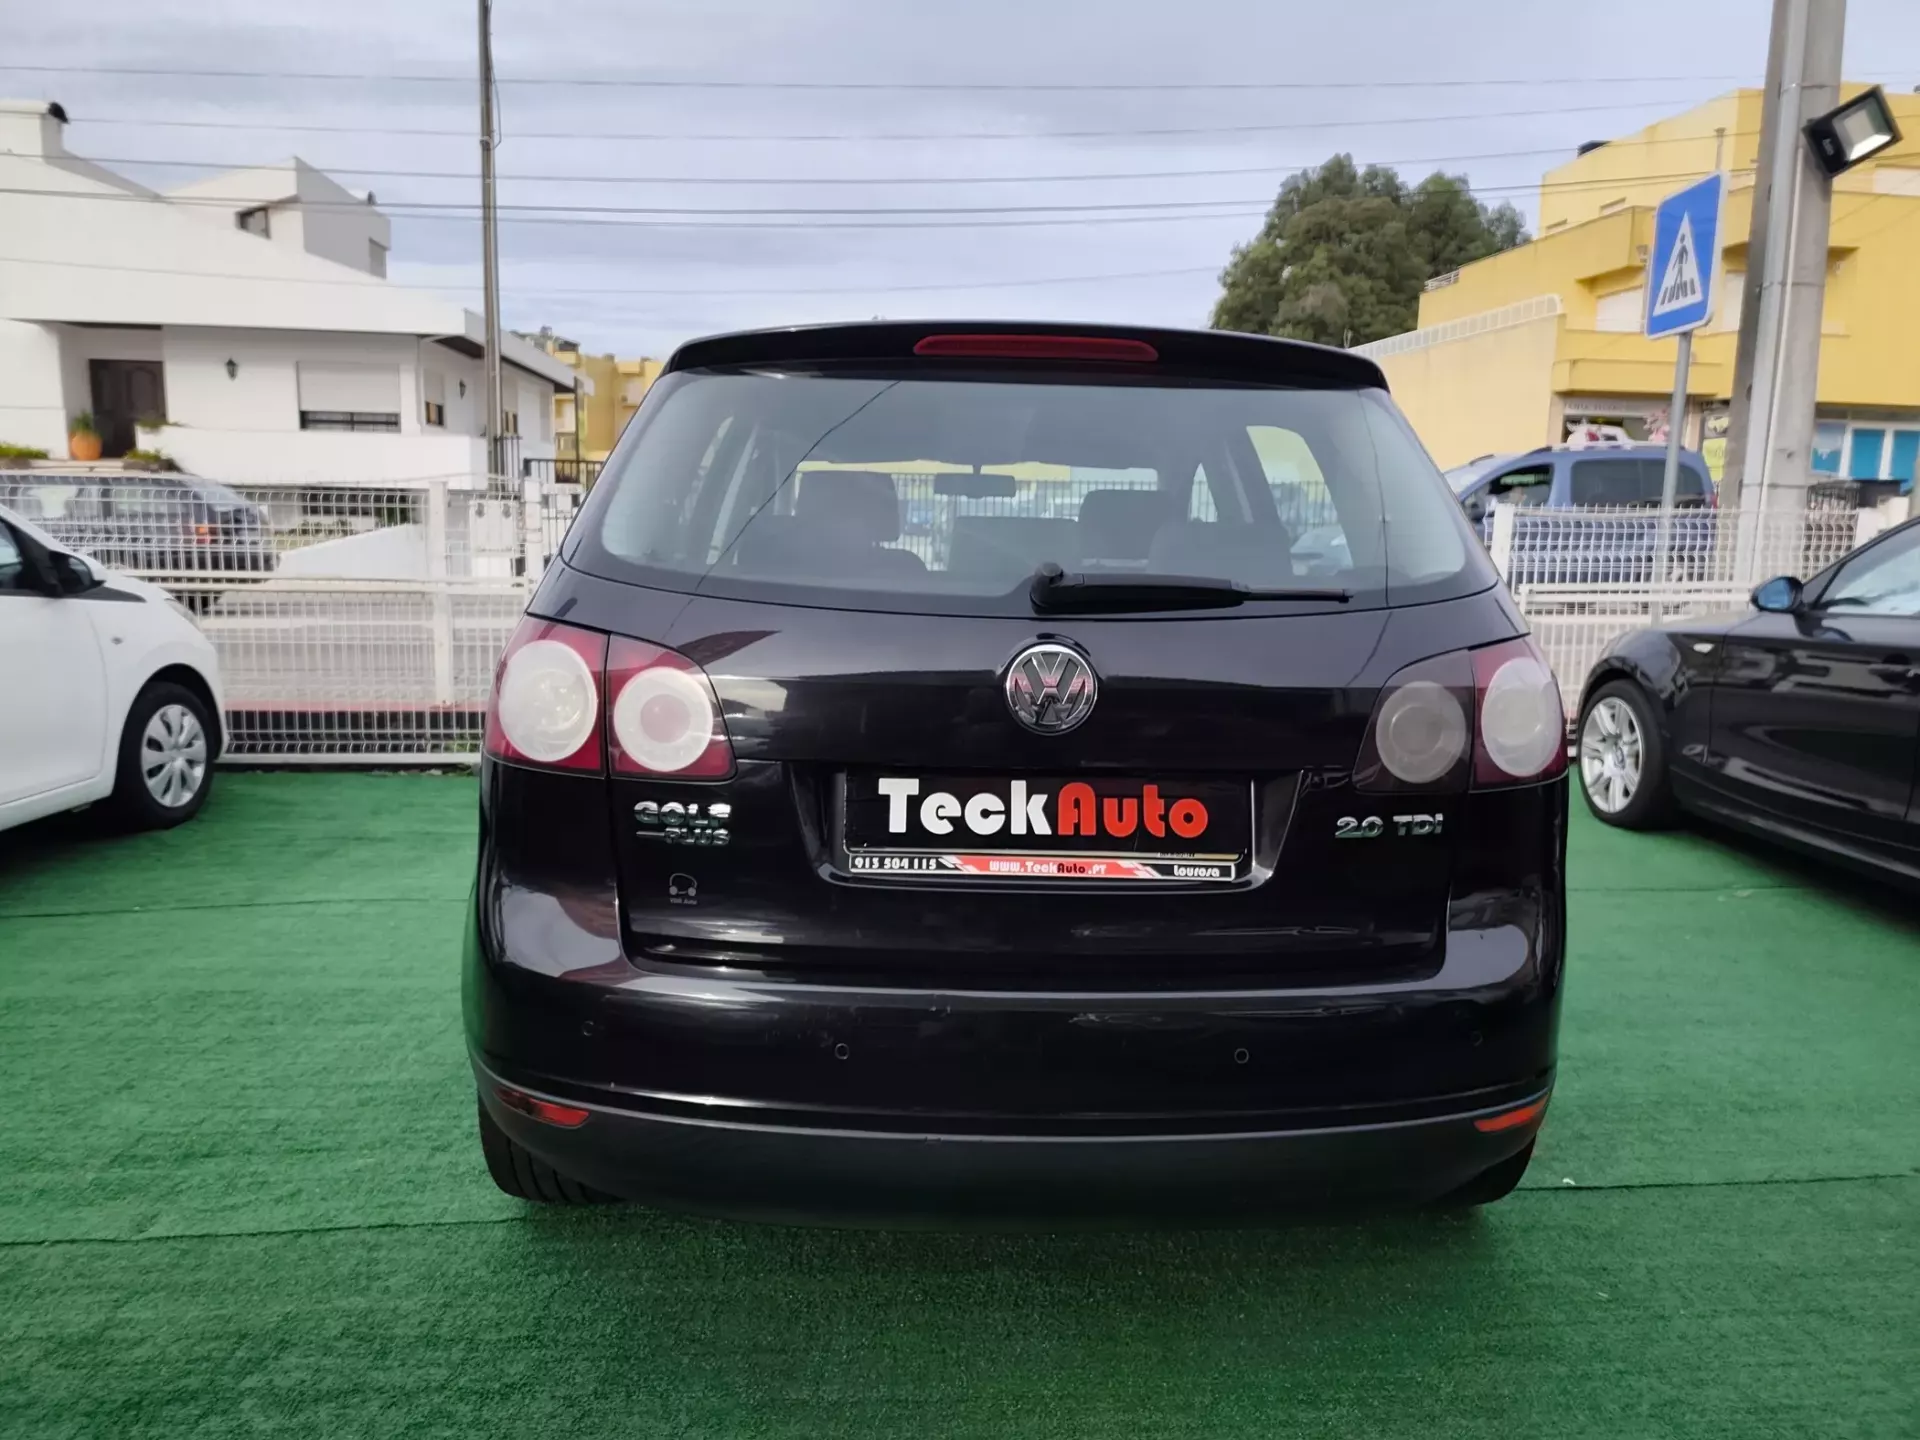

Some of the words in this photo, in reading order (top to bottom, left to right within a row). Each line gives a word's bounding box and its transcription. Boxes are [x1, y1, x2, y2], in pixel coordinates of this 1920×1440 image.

[634, 800, 731, 826] GOLF
[878, 778, 1208, 837] TeckAuto
[884, 857, 909, 869] 504
[913, 858, 937, 870] 115
